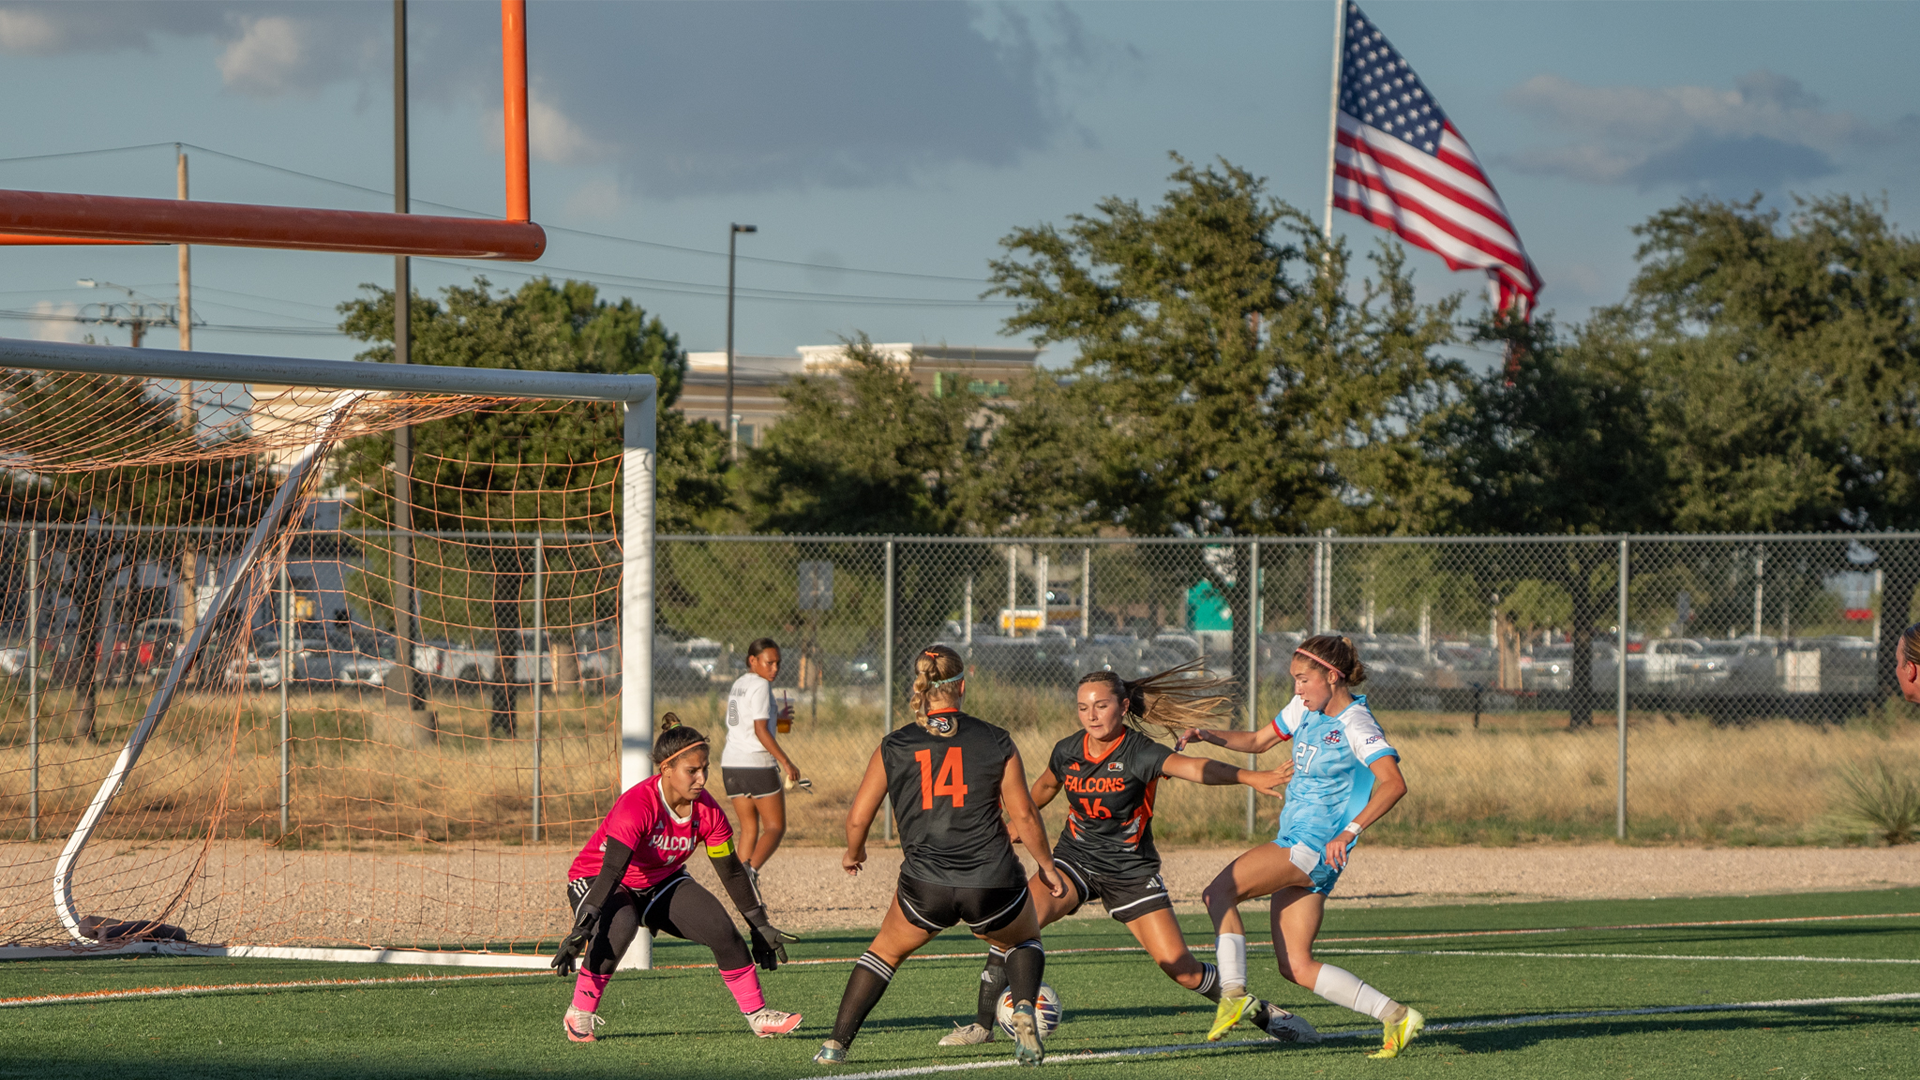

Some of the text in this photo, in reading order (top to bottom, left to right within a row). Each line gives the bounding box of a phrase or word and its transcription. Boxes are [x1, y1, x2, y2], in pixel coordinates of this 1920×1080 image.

[1295, 741, 1319, 775] 27
[914, 746, 968, 810] 14
[1064, 774, 1126, 793] FALCONS
[1078, 797, 1112, 820] 16
